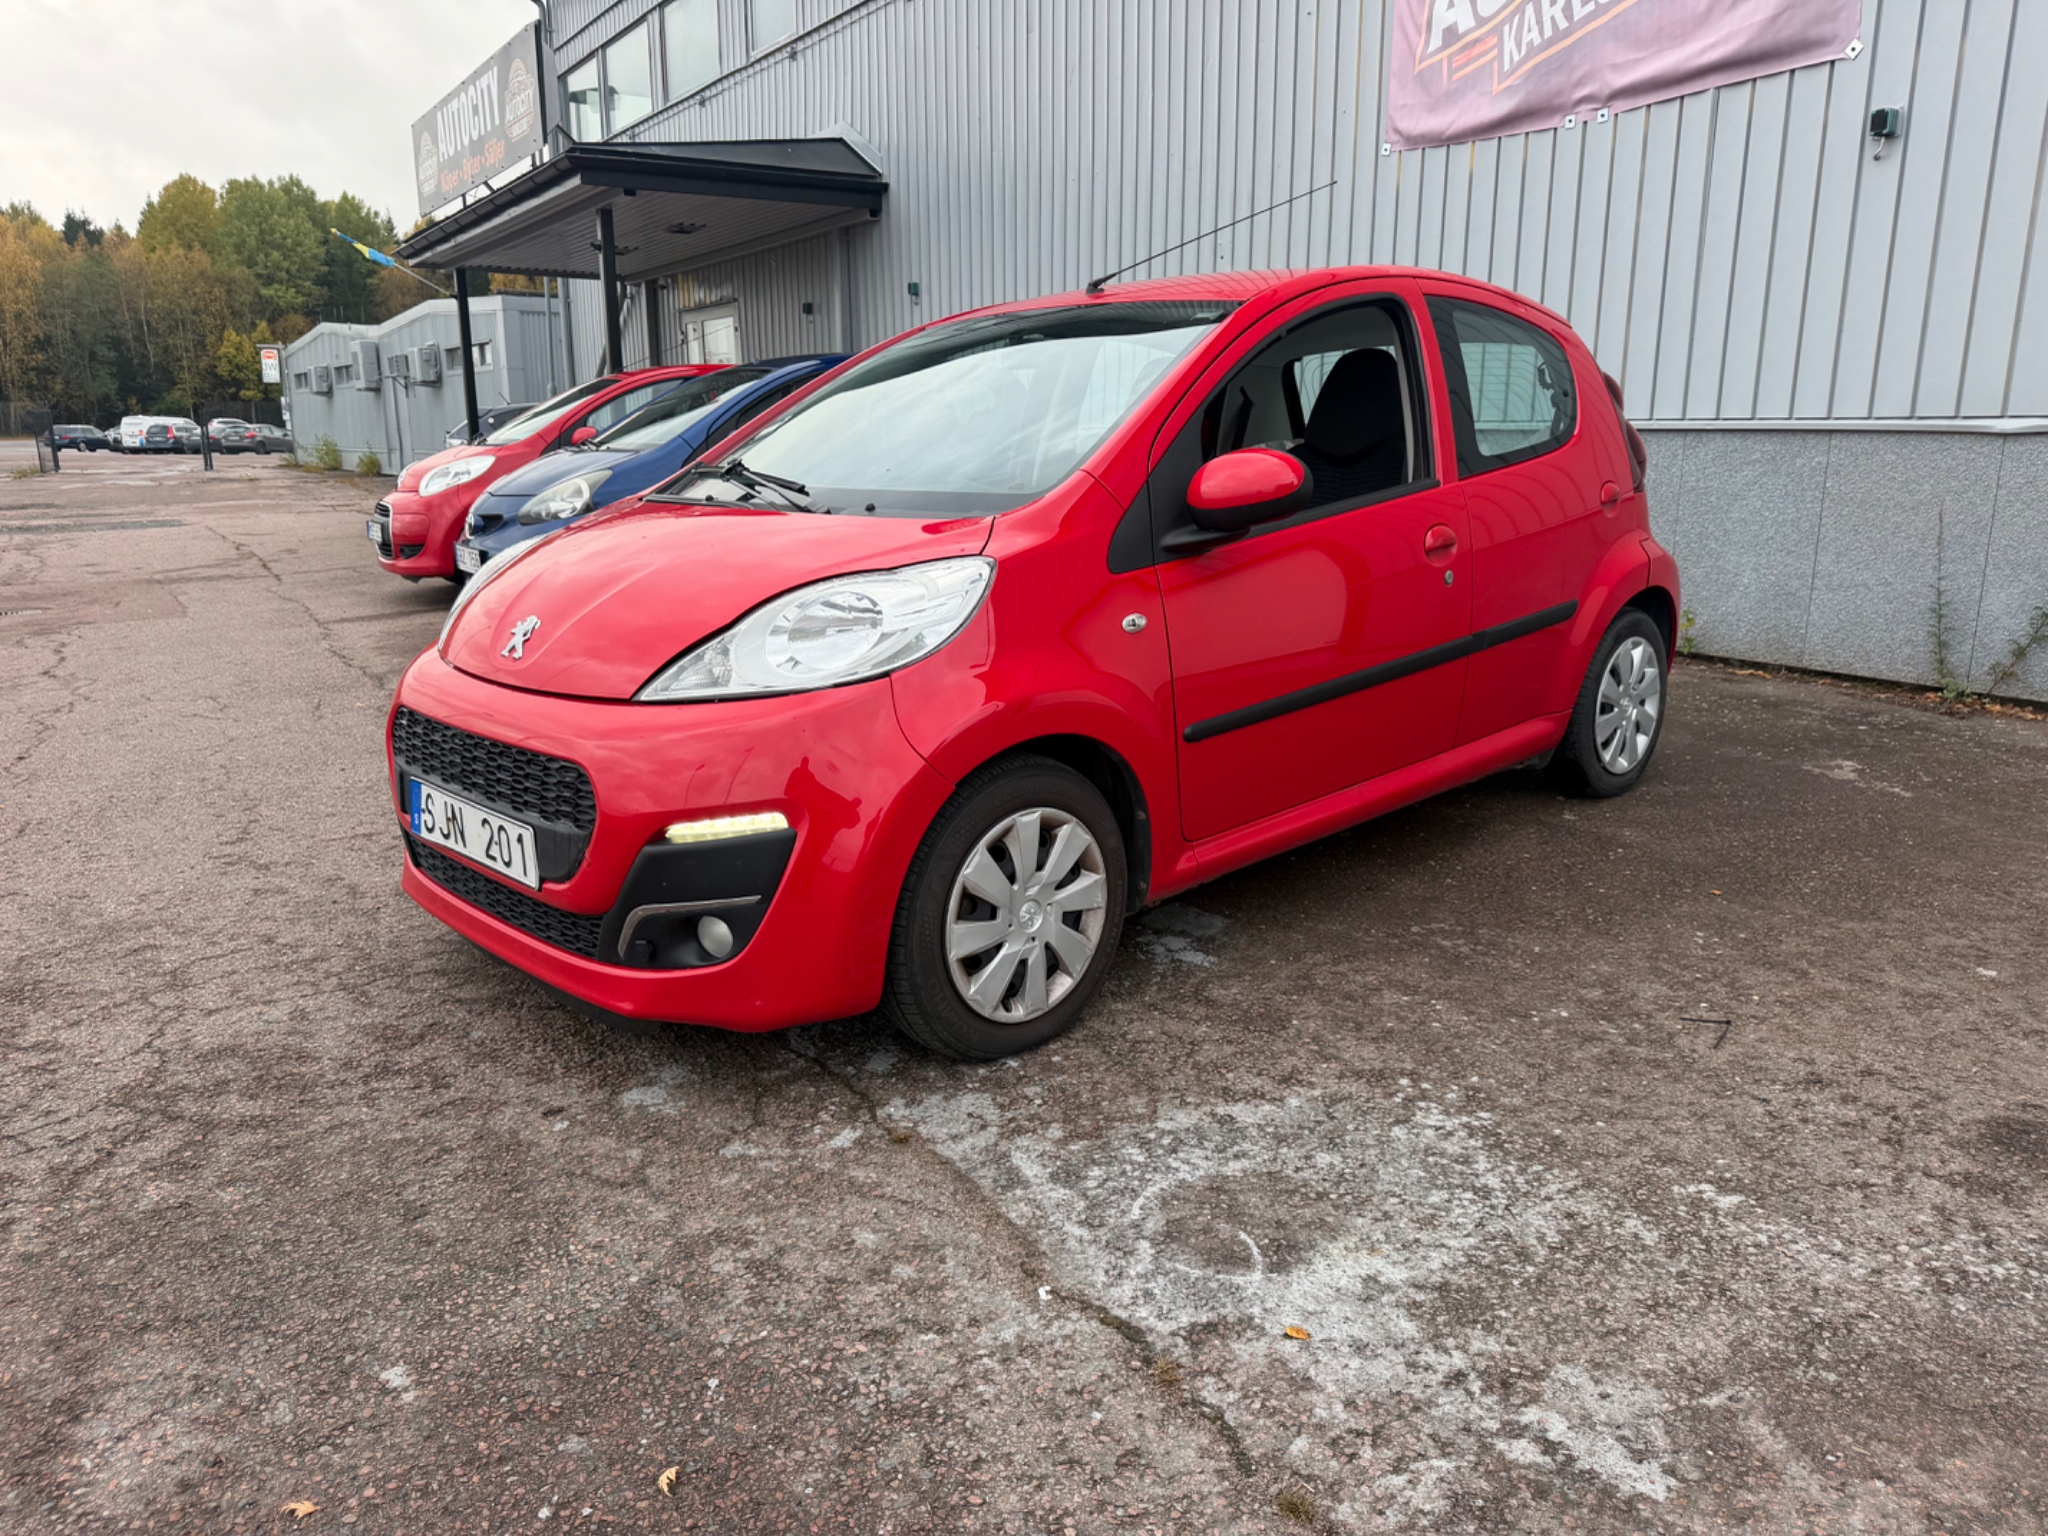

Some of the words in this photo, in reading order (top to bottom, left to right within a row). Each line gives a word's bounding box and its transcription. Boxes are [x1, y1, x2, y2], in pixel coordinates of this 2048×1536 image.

[437, 66, 499, 162] AUTOCITY
[424, 793, 467, 848] SJN
[481, 817, 528, 877] 201
